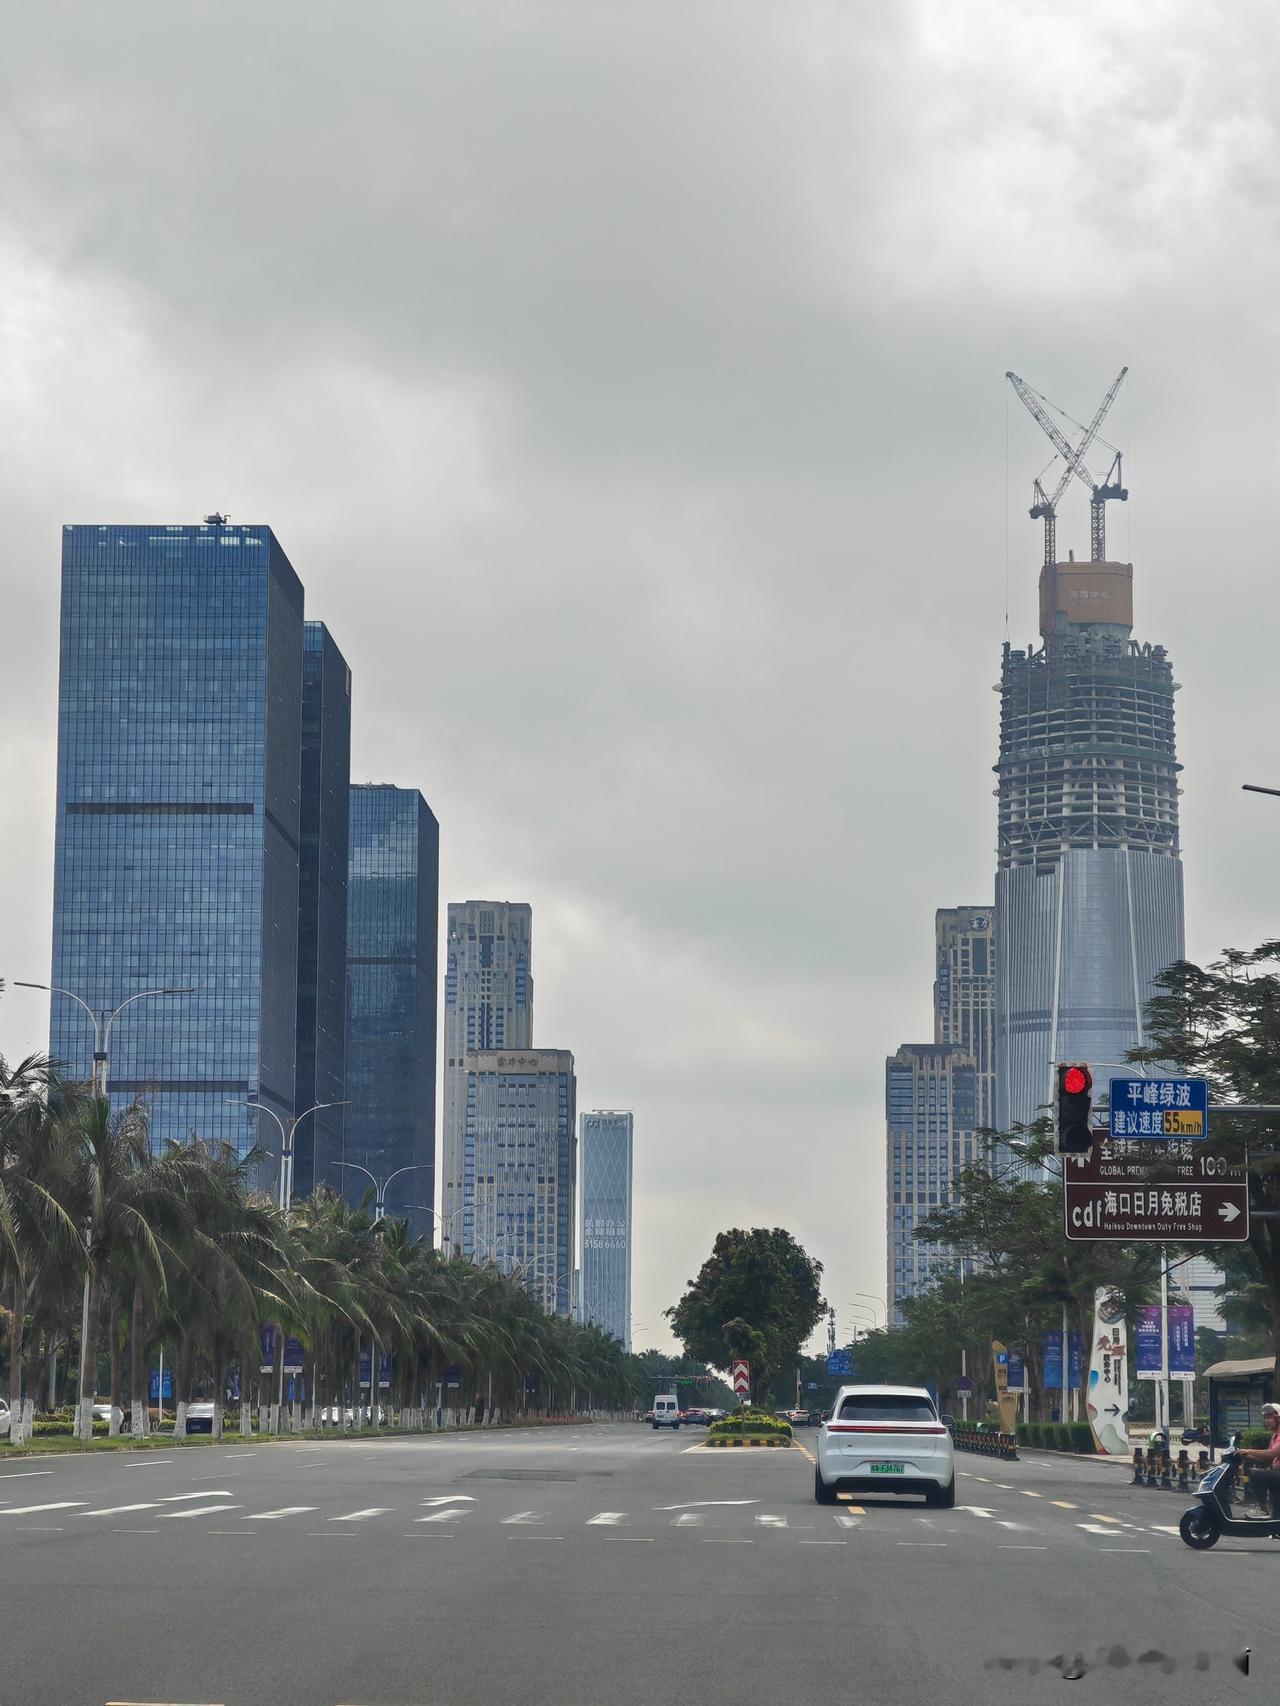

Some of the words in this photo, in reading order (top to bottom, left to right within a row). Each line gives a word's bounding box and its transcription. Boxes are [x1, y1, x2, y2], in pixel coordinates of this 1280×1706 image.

[1127, 1082, 1192, 1107] 平峰绿波
[1114, 1110, 1163, 1134] 建议速度
[1164, 1111, 1203, 1134] 55km/h
[1099, 1165, 1125, 1176] GLOBAL
[1177, 1165, 1194, 1176] FREE
[1072, 1200, 1102, 1228] cdf
[1104, 1190, 1202, 1217] 海口日月免税店
[1103, 1222, 1125, 1231] Haikou
[1126, 1222, 1156, 1231] Downtown
[1157, 1222, 1172, 1232] Duty
[1173, 1222, 1186, 1231] Free
[1187, 1222, 1203, 1232] Shop
